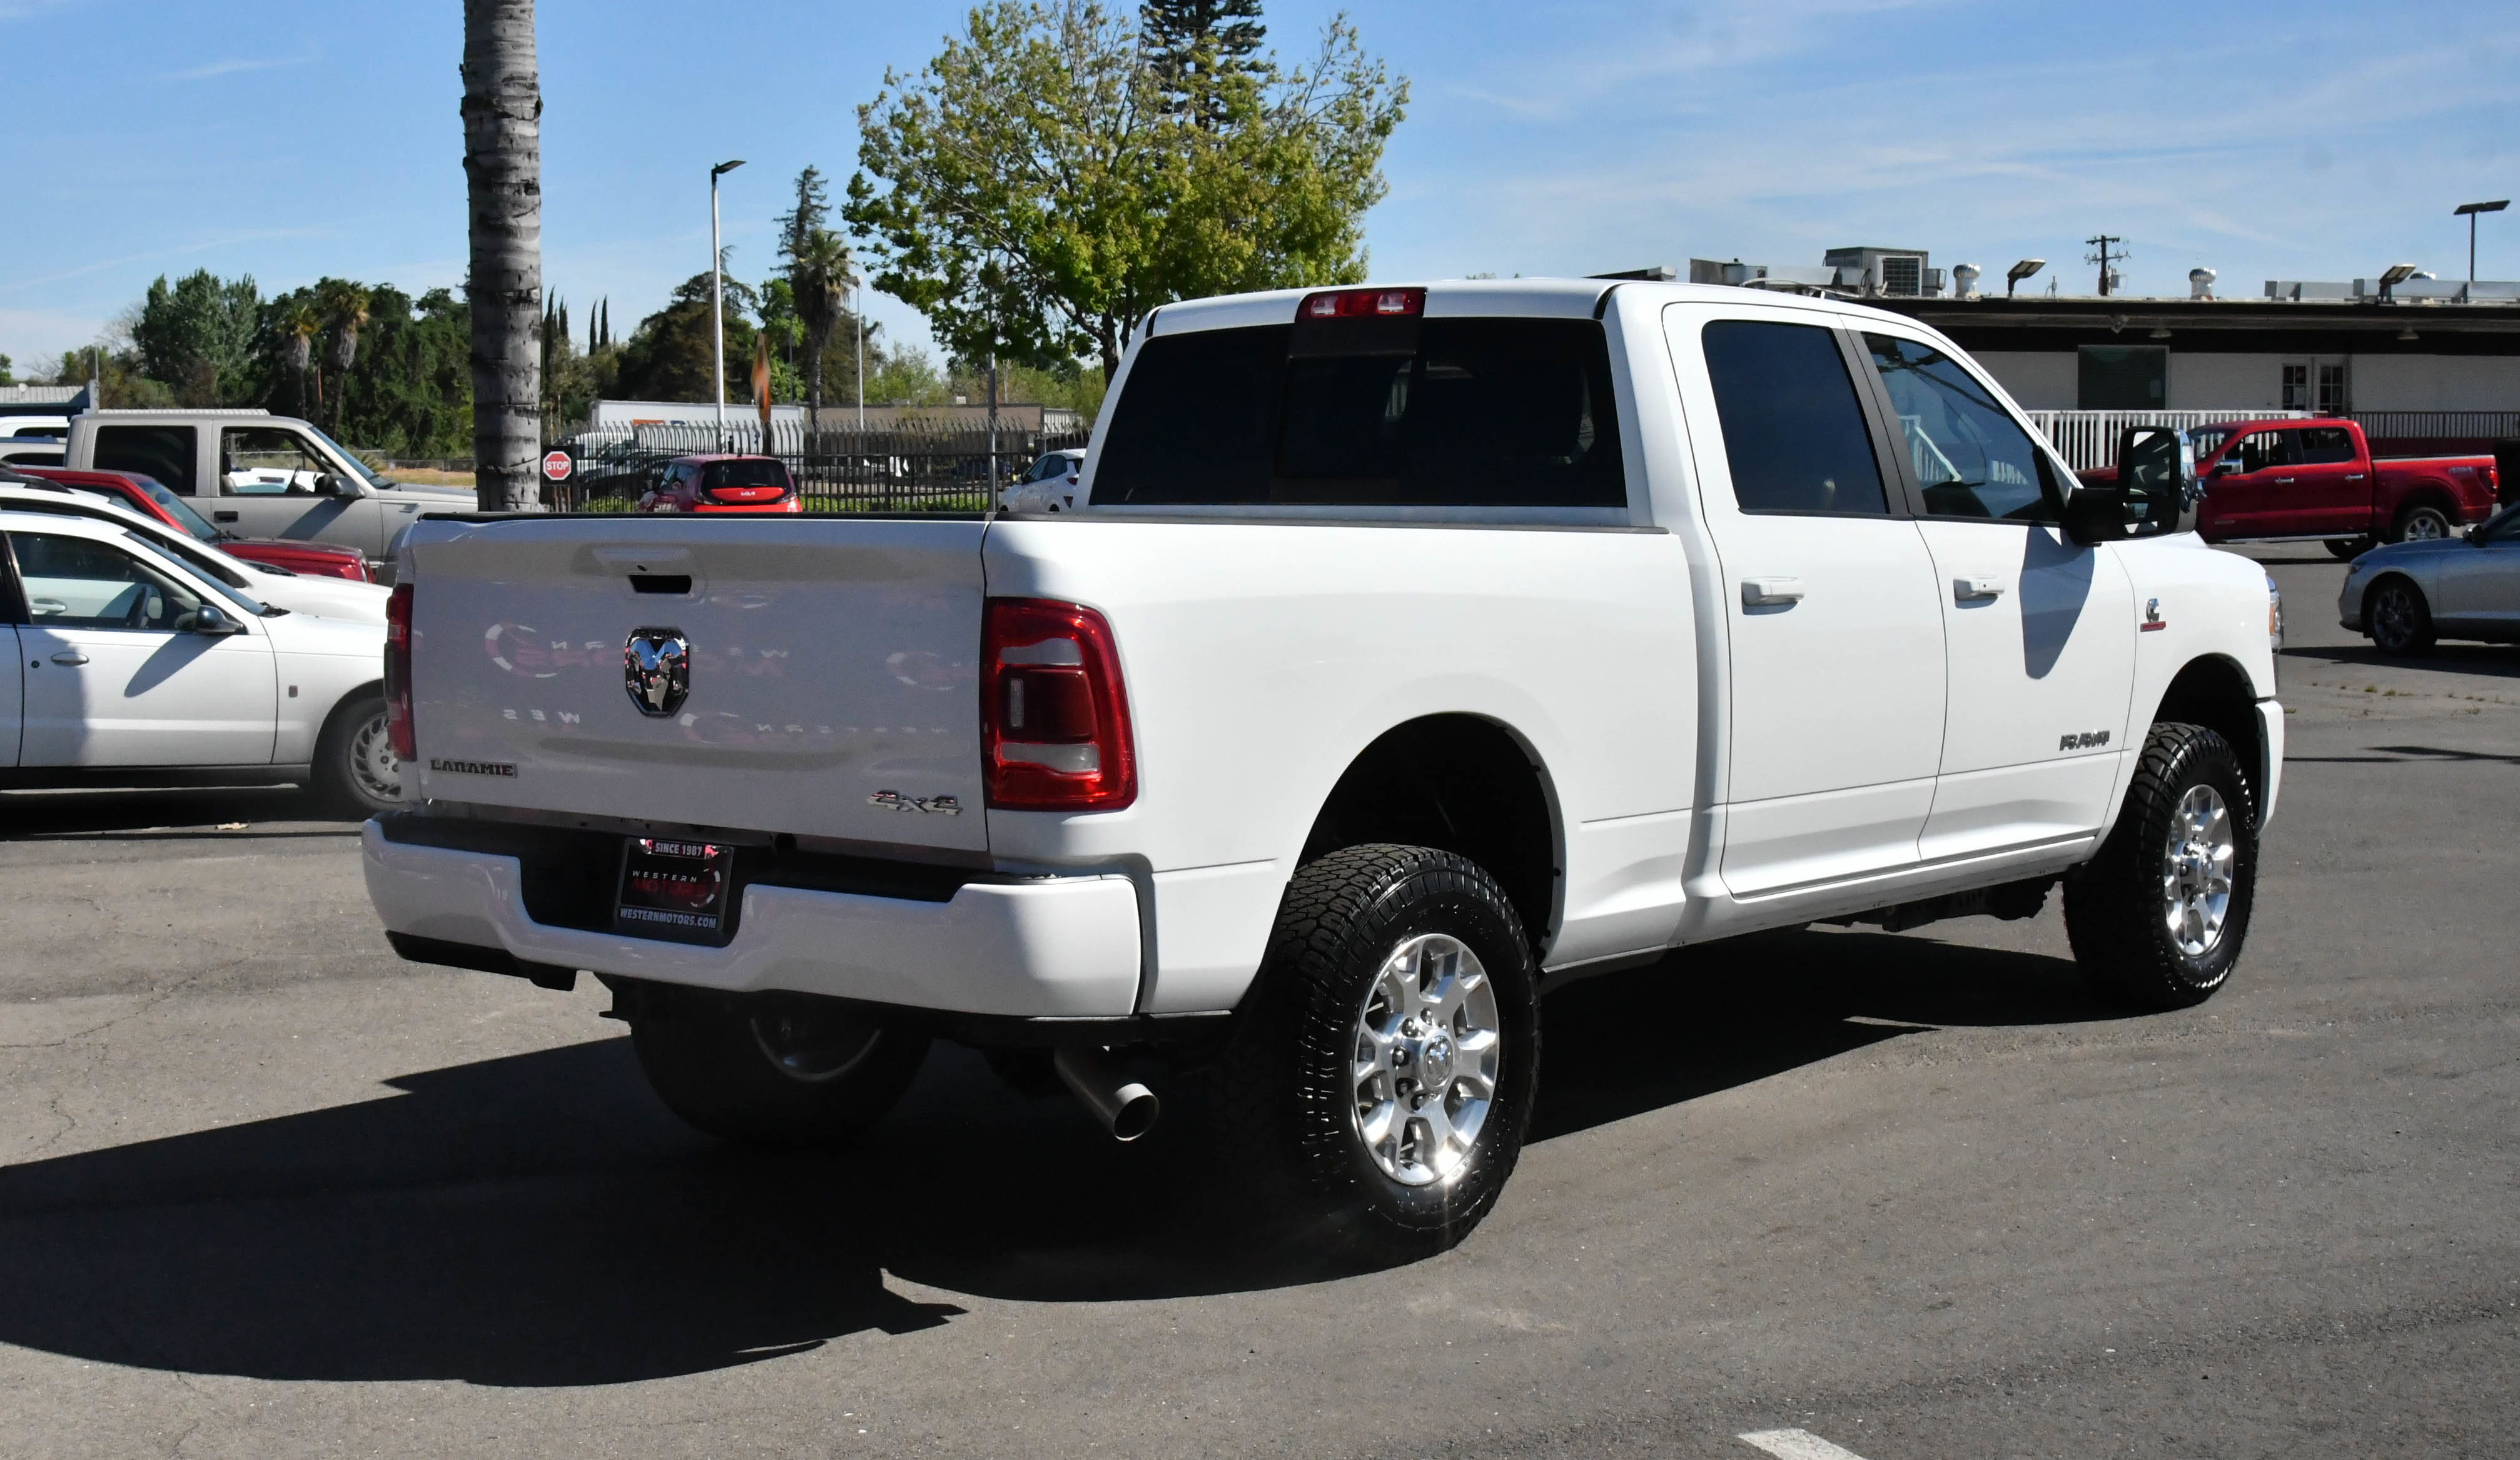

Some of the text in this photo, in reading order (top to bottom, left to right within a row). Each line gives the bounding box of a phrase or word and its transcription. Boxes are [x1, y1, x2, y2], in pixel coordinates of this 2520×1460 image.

[547, 461, 569, 470] STOP
[2059, 730, 2110, 751] RAM
[430, 759, 514, 777] LARAMIE
[655, 842, 702, 857] SINCE 1987
[633, 870, 697, 882] WESTERN
[620, 908, 717, 929] WESTERNMOTORS.COM
